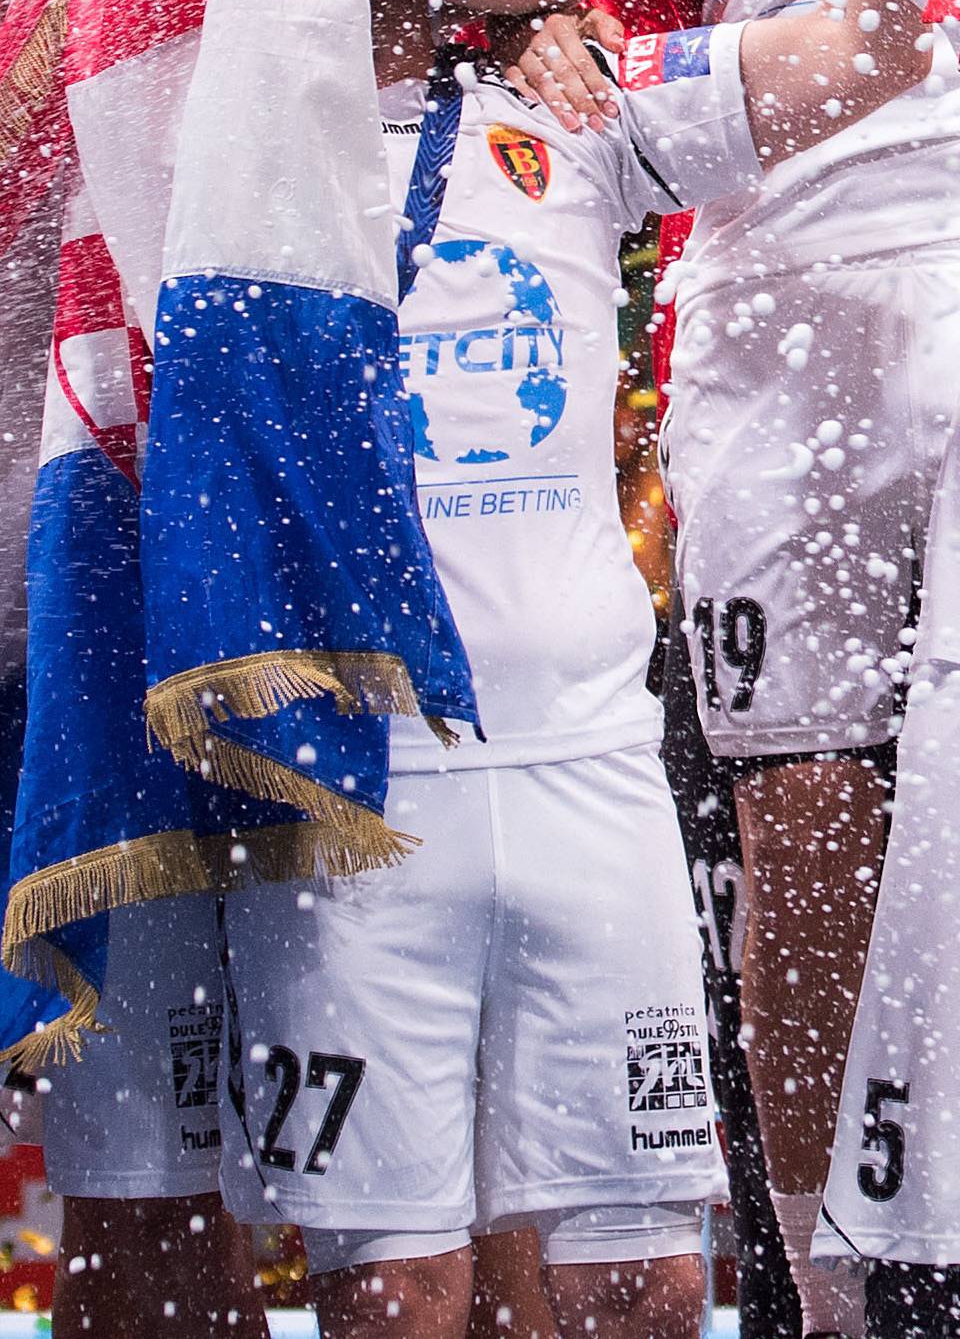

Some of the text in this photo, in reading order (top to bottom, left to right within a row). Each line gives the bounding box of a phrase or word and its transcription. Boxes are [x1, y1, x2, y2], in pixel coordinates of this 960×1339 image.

[480, 488, 582, 515] BETTING
[693, 596, 768, 712] 19
[259, 1044, 367, 1176] 27
[630, 1121, 712, 1150] hummel
[857, 1078, 910, 1201] 5
